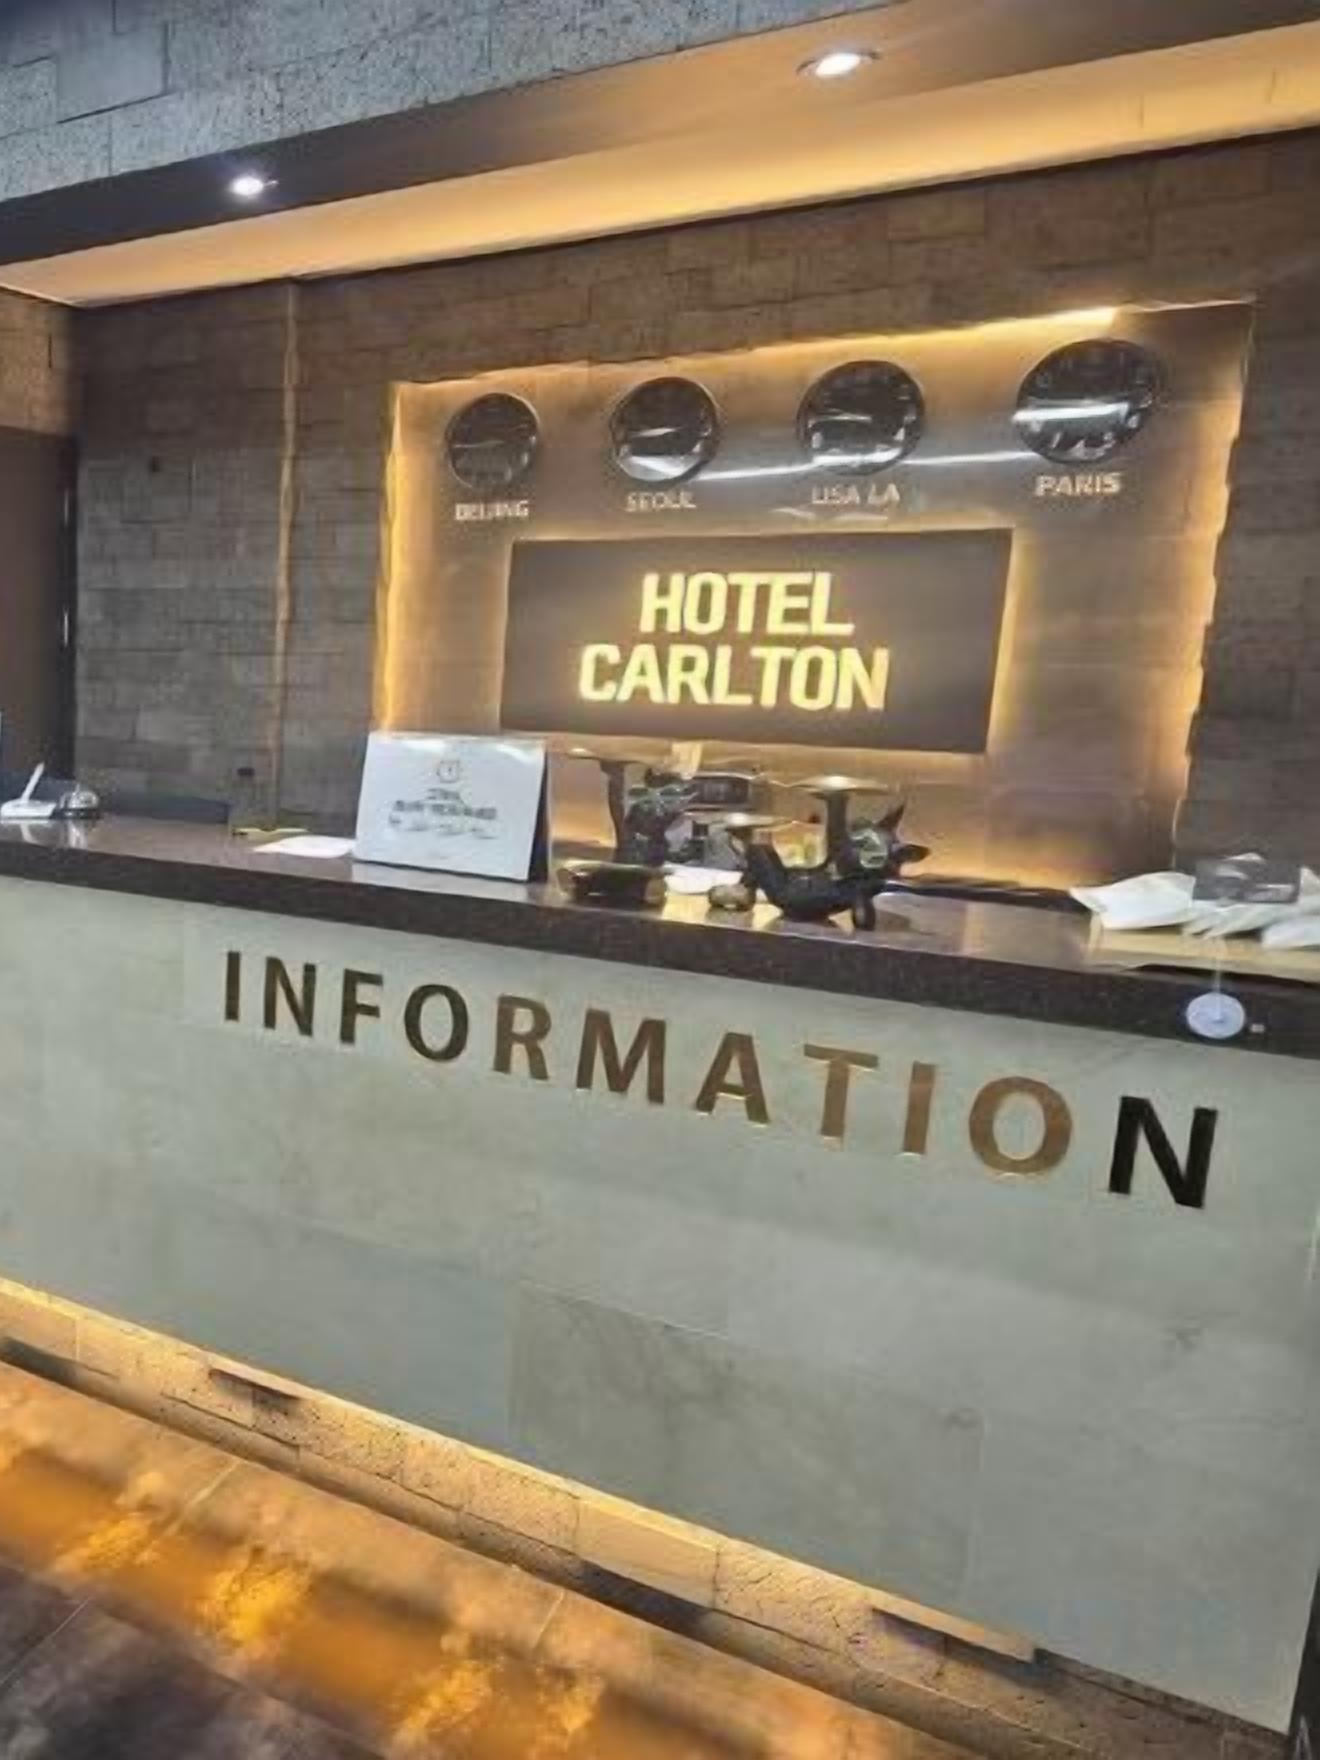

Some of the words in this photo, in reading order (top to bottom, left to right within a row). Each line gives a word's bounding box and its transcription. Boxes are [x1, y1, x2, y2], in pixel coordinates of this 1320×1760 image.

[626, 491, 696, 512] SEOUL
[1035, 471, 1122, 497] PARIS
[639, 571, 855, 635] HOTEL
[578, 643, 890, 711] CARLTON
[224, 950, 1219, 1209] INFORMATION
